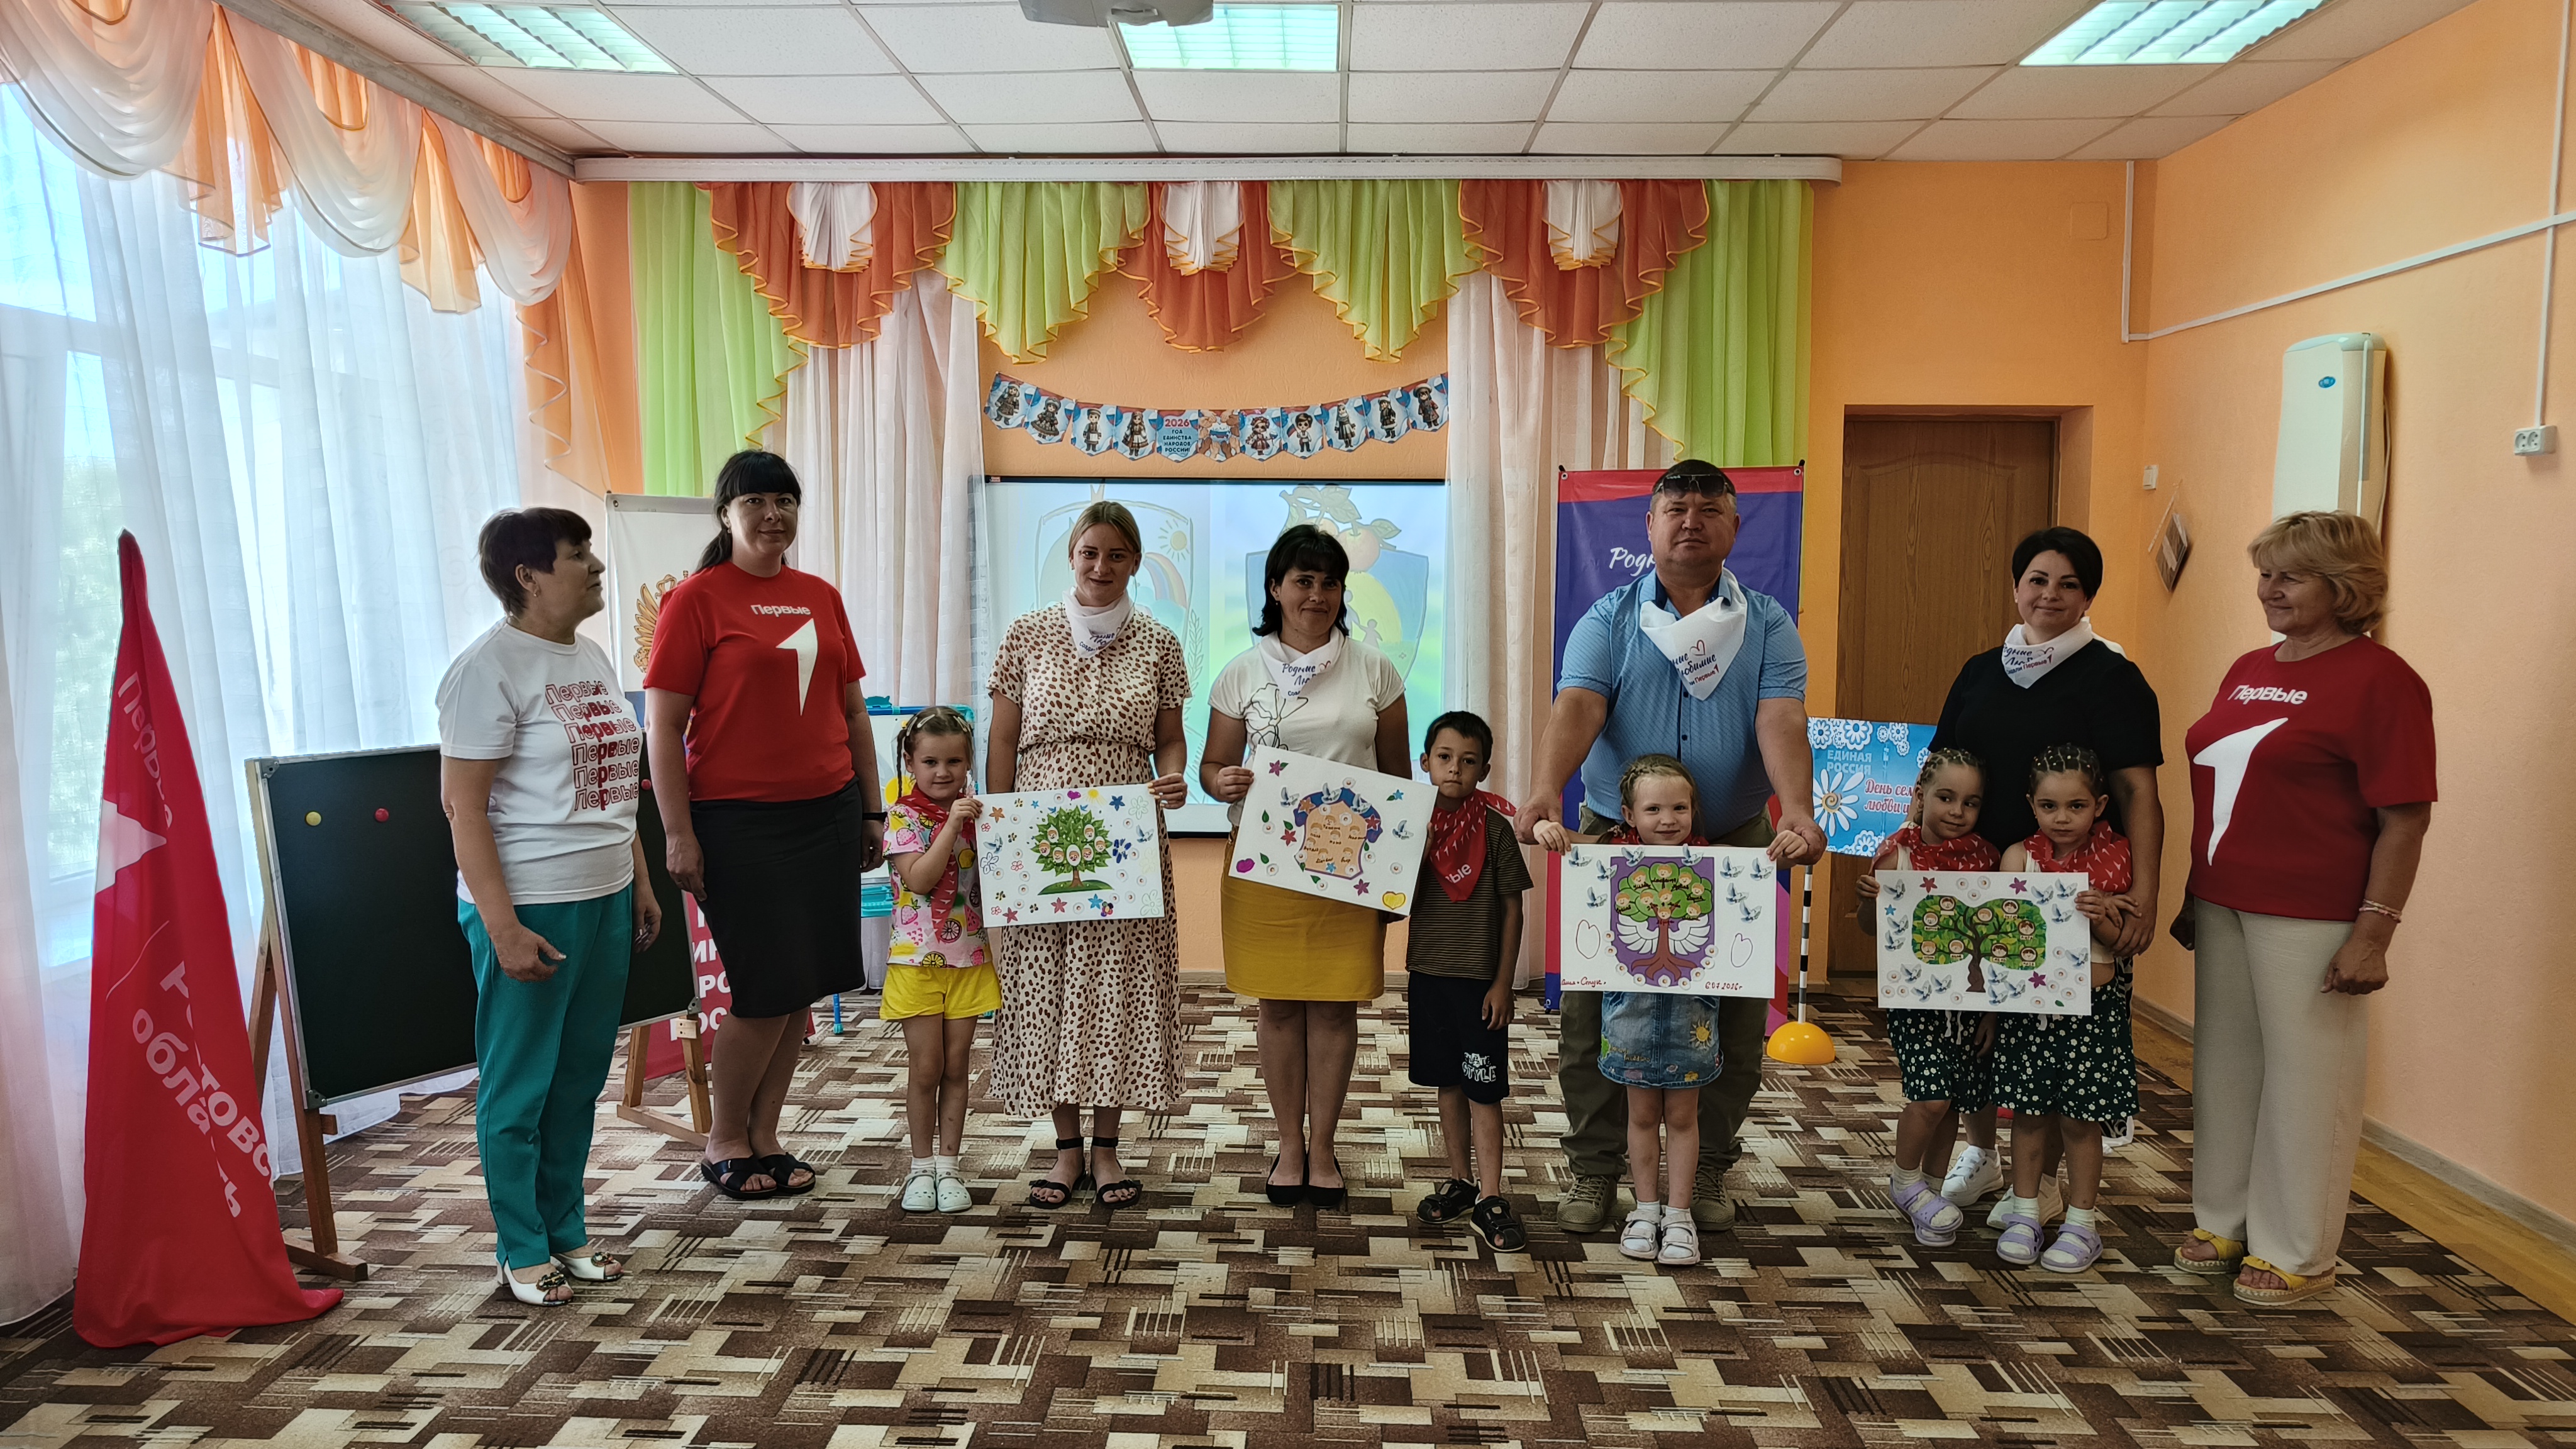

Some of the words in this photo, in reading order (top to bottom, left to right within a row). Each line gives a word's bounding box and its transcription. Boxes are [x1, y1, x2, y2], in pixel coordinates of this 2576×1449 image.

[1165, 418, 1190, 427] 2026
[750, 604, 811, 617] Первые
[1282, 663, 1316, 677] Родные
[1677, 654, 1717, 676] юбимые
[2023, 658, 2047, 670] Первые
[1694, 670, 1716, 684] Первые
[545, 680, 609, 704] Первые
[2227, 685, 2307, 705] Первые
[551, 699, 623, 722] Первые
[564, 718, 636, 743] Первые
[571, 737, 640, 765] Первые
[1827, 750, 1872, 762] ЕДИНАЯ
[574, 760, 639, 789] Первые
[1826, 762, 1872, 775] РОССИЯ
[574, 782, 639, 811] Первые
[1865, 779, 1892, 796] День
[1864, 798, 1901, 813] любви
[1462, 1062, 1496, 1083] STYLE
